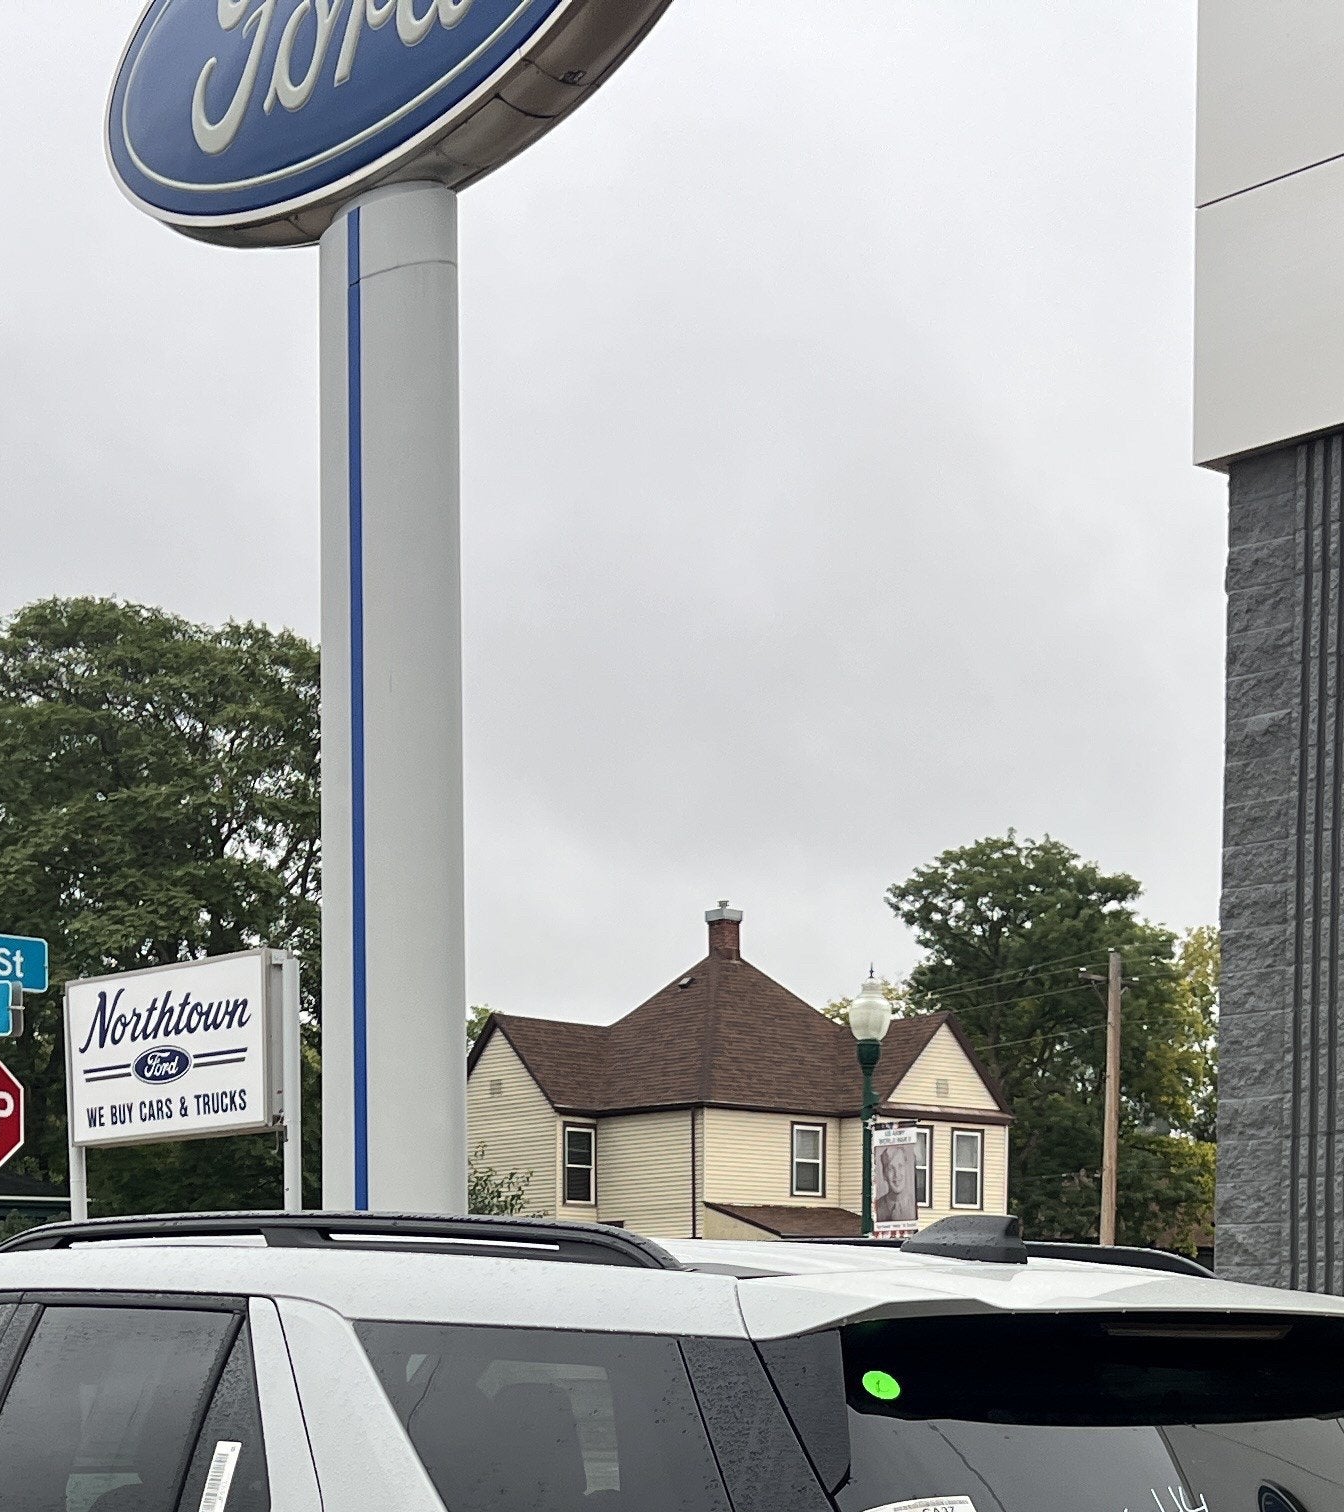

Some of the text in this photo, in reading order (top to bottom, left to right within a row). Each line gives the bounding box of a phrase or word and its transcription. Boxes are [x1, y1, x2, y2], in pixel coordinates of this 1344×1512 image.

[79, 988, 251, 1053] Northtown
[144, 1051, 179, 1078] Ford
[86, 1088, 247, 1128] WE BUY CARS & TRUCKS
